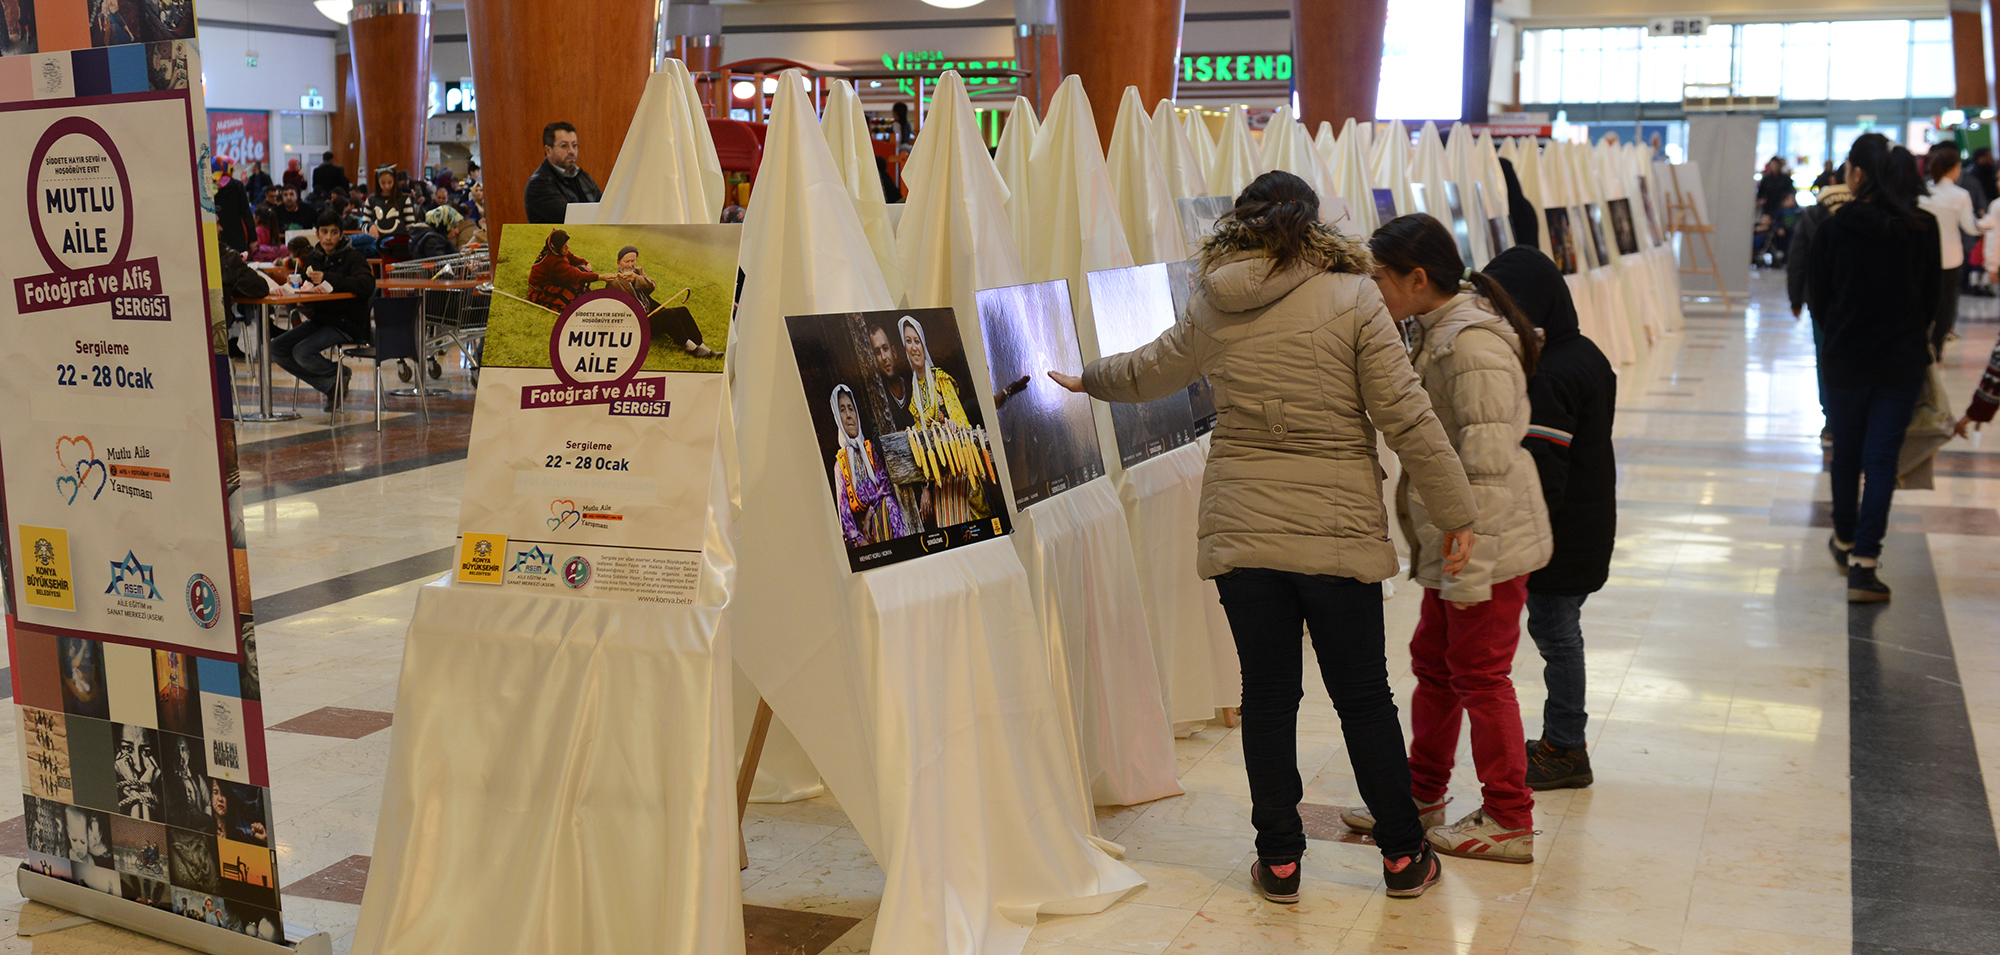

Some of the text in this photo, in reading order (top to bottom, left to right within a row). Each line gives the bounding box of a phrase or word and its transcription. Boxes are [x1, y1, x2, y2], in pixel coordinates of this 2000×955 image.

[906, 50, 944, 62] BURSA
[216, 135, 264, 165] Köfte
[46, 156, 68, 165] ŞİDDETE
[86, 154, 100, 163] SEVGİ
[55, 165, 86, 175] HOŞGÖRÜYE
[46, 186, 114, 213] MUTLU
[63, 222, 108, 253] AİLE
[24, 266, 152, 304] Fotoğraf ve Afiş
[568, 331, 632, 348] MUTLU
[76, 340, 129, 357] Sergileme
[574, 353, 618, 373] AİLE
[57, 364, 77, 386] 22
[92, 365, 112, 387] 28
[116, 366, 154, 389] Ocak
[530, 382, 655, 404] Fotoğraf ve Afiş
[107, 446, 150, 460] Mutlu Aile
[566, 440, 612, 451] Sergileme
[545, 455, 562, 468] 22
[575, 456, 592, 469] 28
[596, 457, 629, 471] Ocak
[110, 478, 152, 500] Yarışması
[581, 519, 608, 529] Yarışması
[36, 566, 57, 577] KONYA
[462, 562, 499, 572] BÜYÜKŞEHİR
[27, 574, 69, 590] BÜYÜKŞEHİR
[129, 600, 146, 609] EĞİTİM
[638, 596, 692, 605] www.konya.bel.tr
[107, 608, 164, 622] SANAT MERKEZİ (ASEM)
